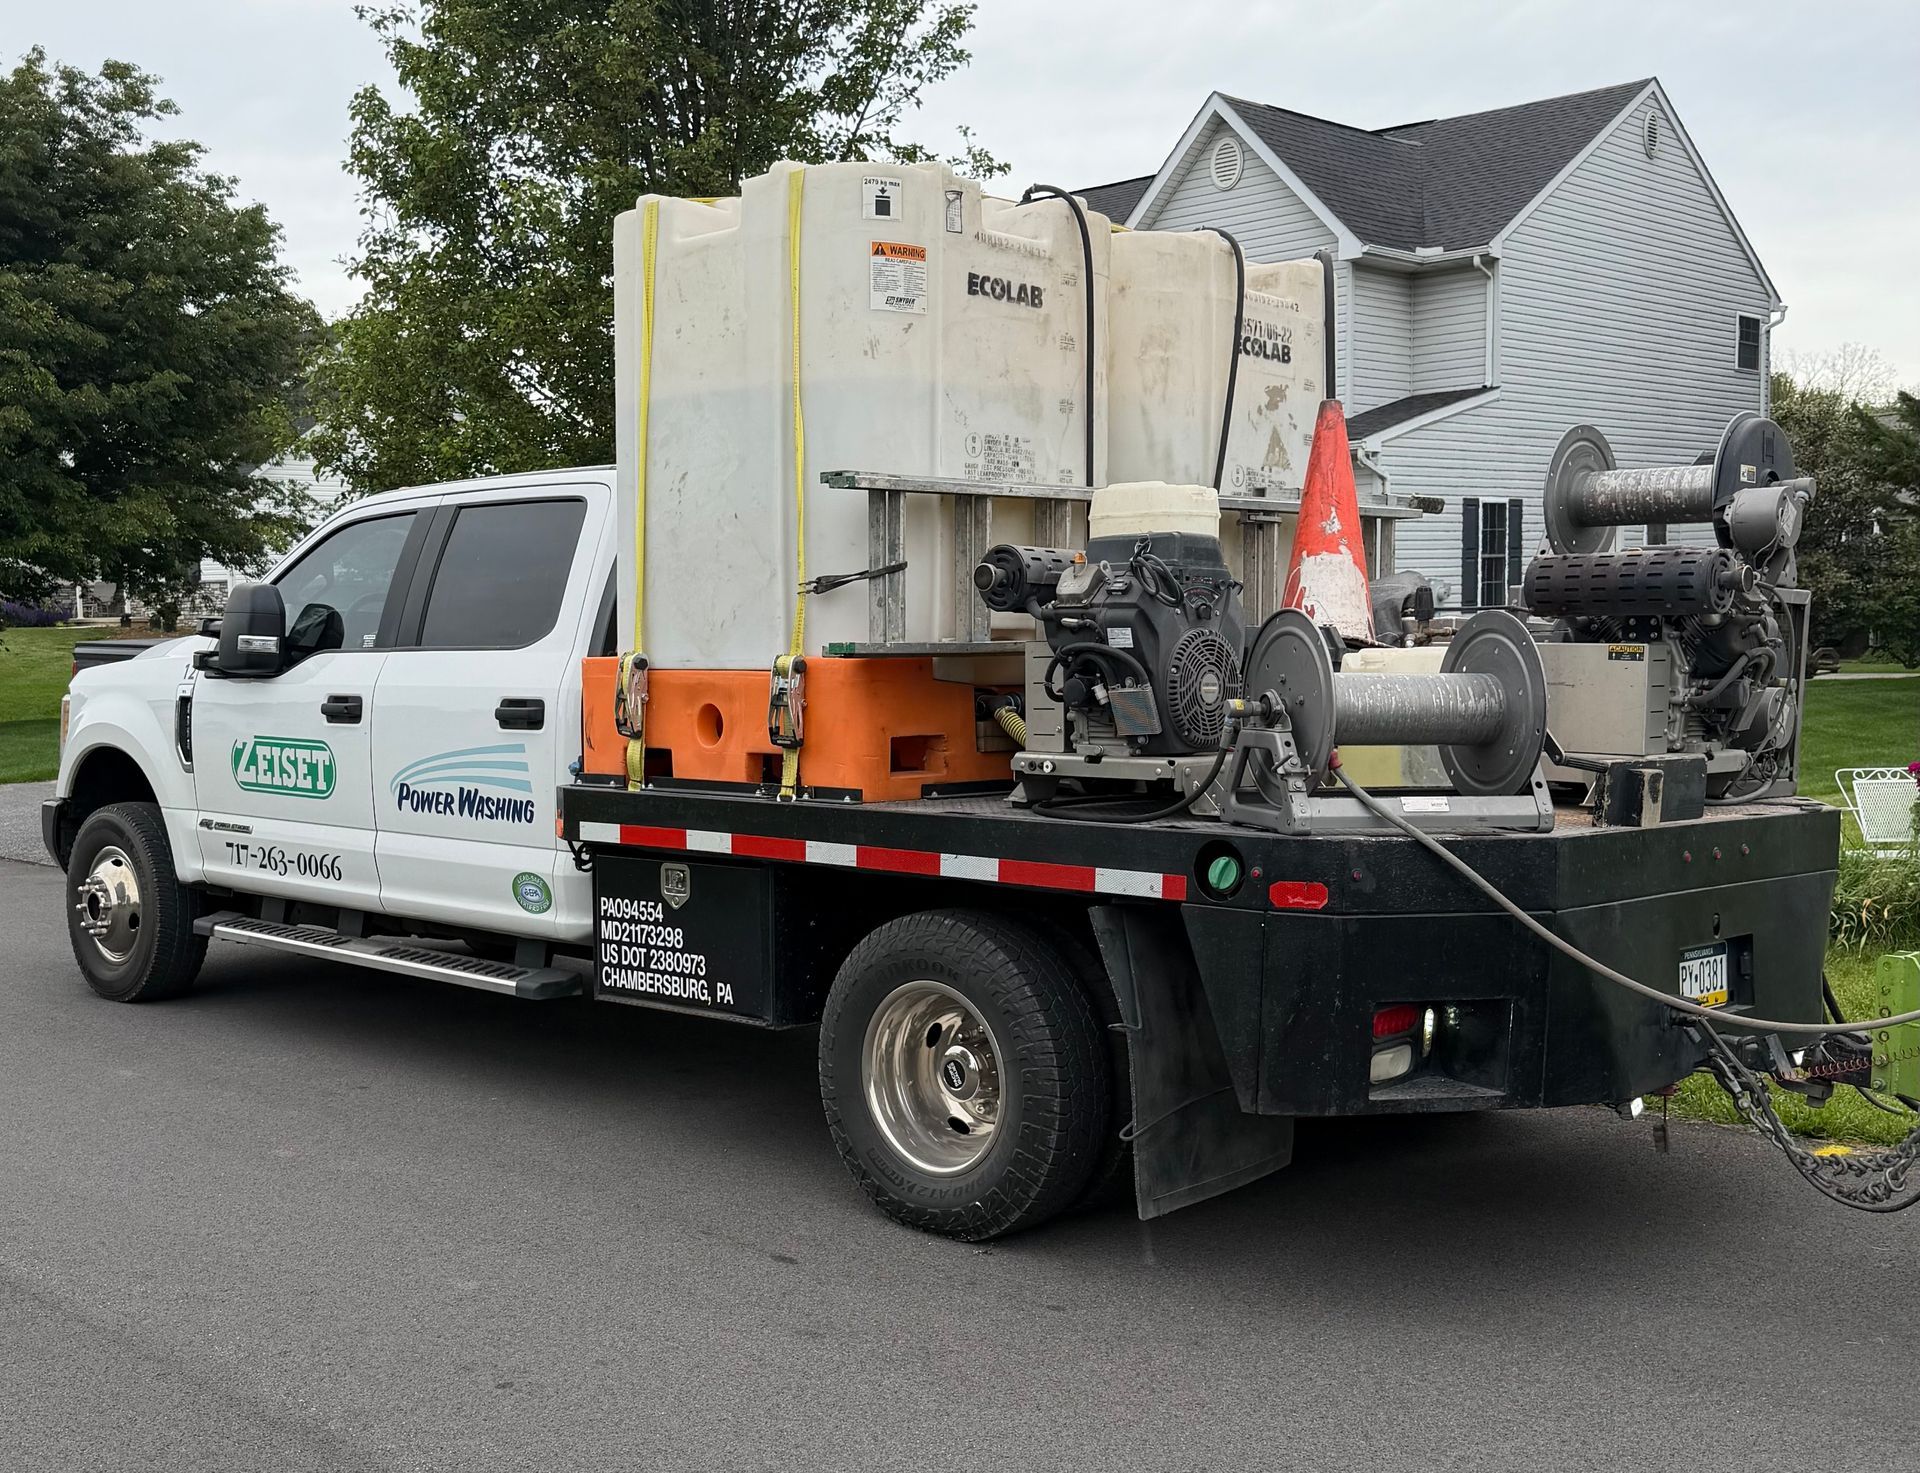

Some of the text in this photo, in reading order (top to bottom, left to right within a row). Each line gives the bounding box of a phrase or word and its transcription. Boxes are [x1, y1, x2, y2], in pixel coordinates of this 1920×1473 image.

[889, 245, 925, 259] WARNING
[967, 271, 1043, 309] ECOLAB
[235, 736, 330, 791] ZEISET
[397, 782, 535, 824] POWER WASHING
[225, 841, 343, 882] 717-263-0066
[600, 896, 664, 922] PA094554
[601, 919, 684, 949] MD21173298
[601, 942, 706, 976] US DOT 2380973
[1684, 947, 1714, 960] PENNSYLVANIA
[602, 966, 734, 1006] CHAMBERSBURG, PA
